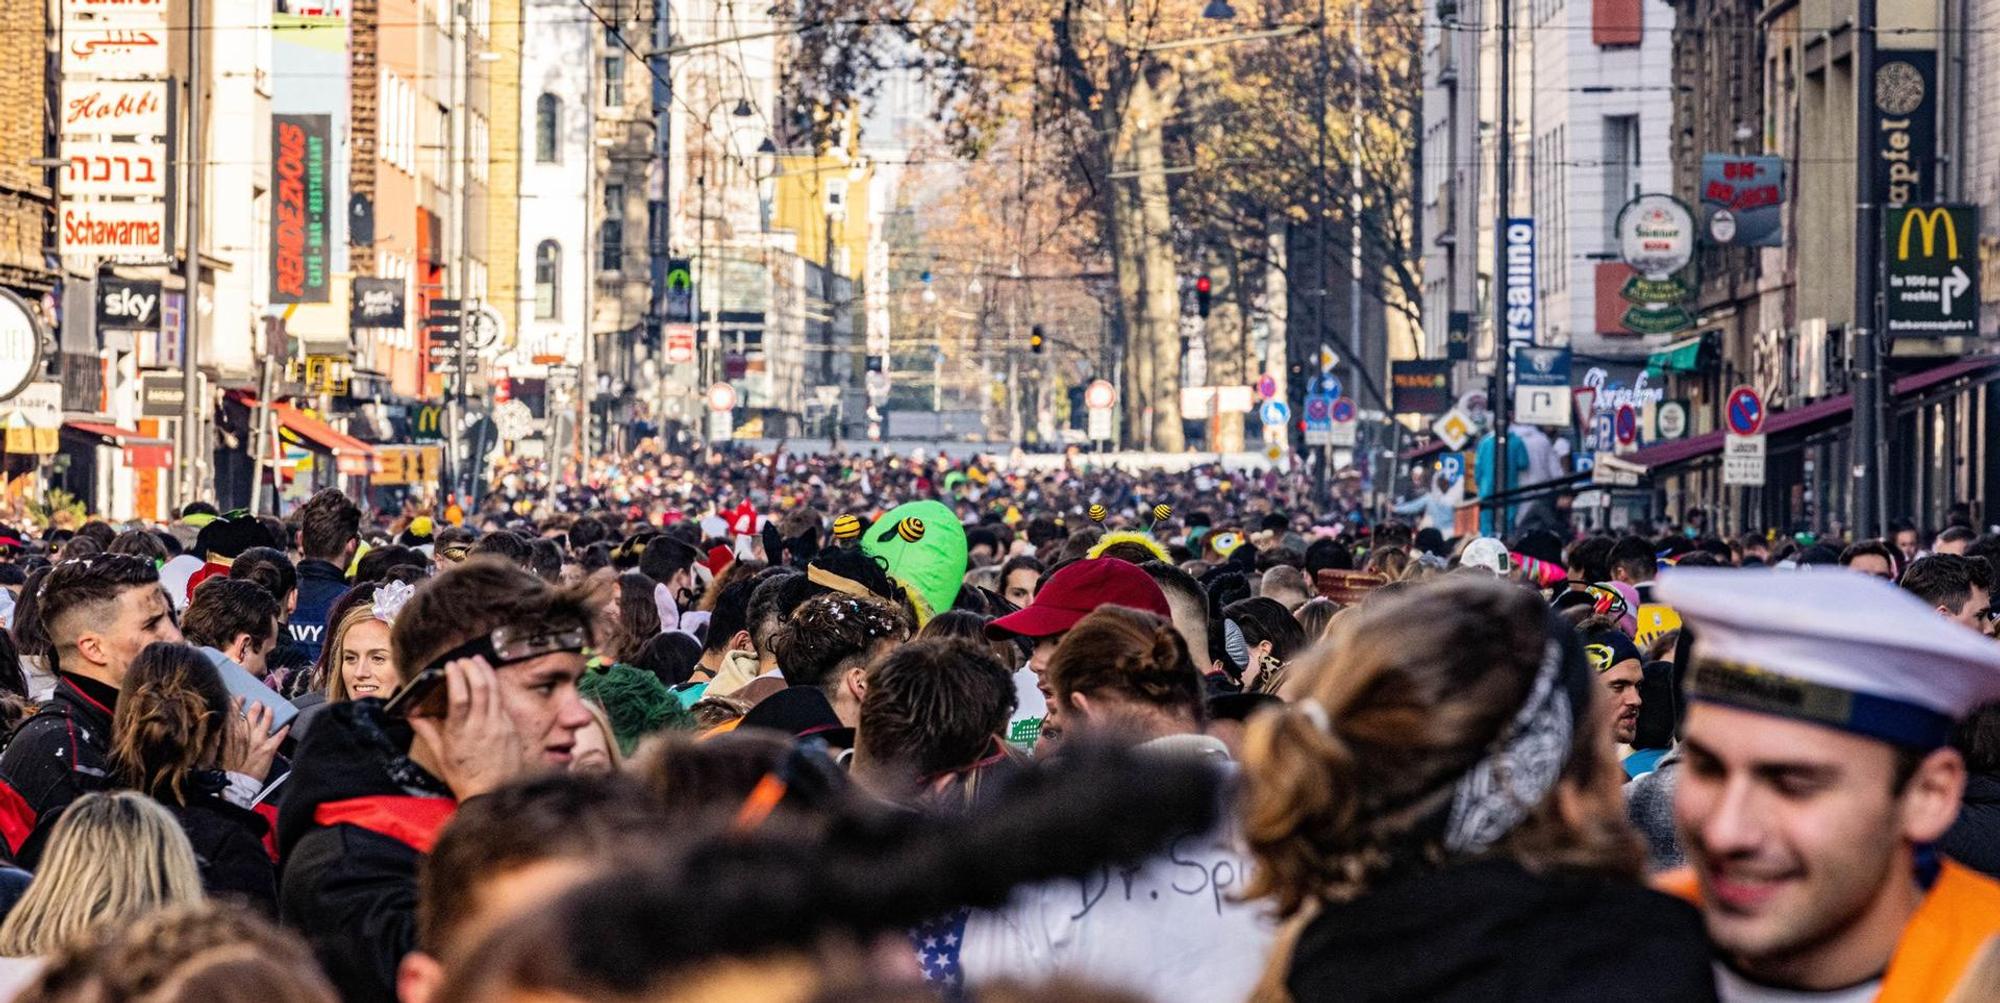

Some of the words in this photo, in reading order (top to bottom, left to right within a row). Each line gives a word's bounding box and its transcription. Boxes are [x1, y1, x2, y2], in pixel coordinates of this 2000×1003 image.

[71, 29, 158, 60] حبيبي
[67, 91, 158, 124] Habibi
[70, 156, 156, 182] ברכה
[308, 136, 323, 213] RESTAURANT
[277, 121, 305, 296] RENDEZVOUS
[66, 210, 160, 245] Schawarma
[1890, 274, 1904, 287] in
[1905, 275, 1927, 287] 100
[1928, 276, 1940, 287] m
[1901, 289, 1940, 302] rechts
[105, 287, 156, 322] sky
[1071, 861, 1158, 921] Dr.
